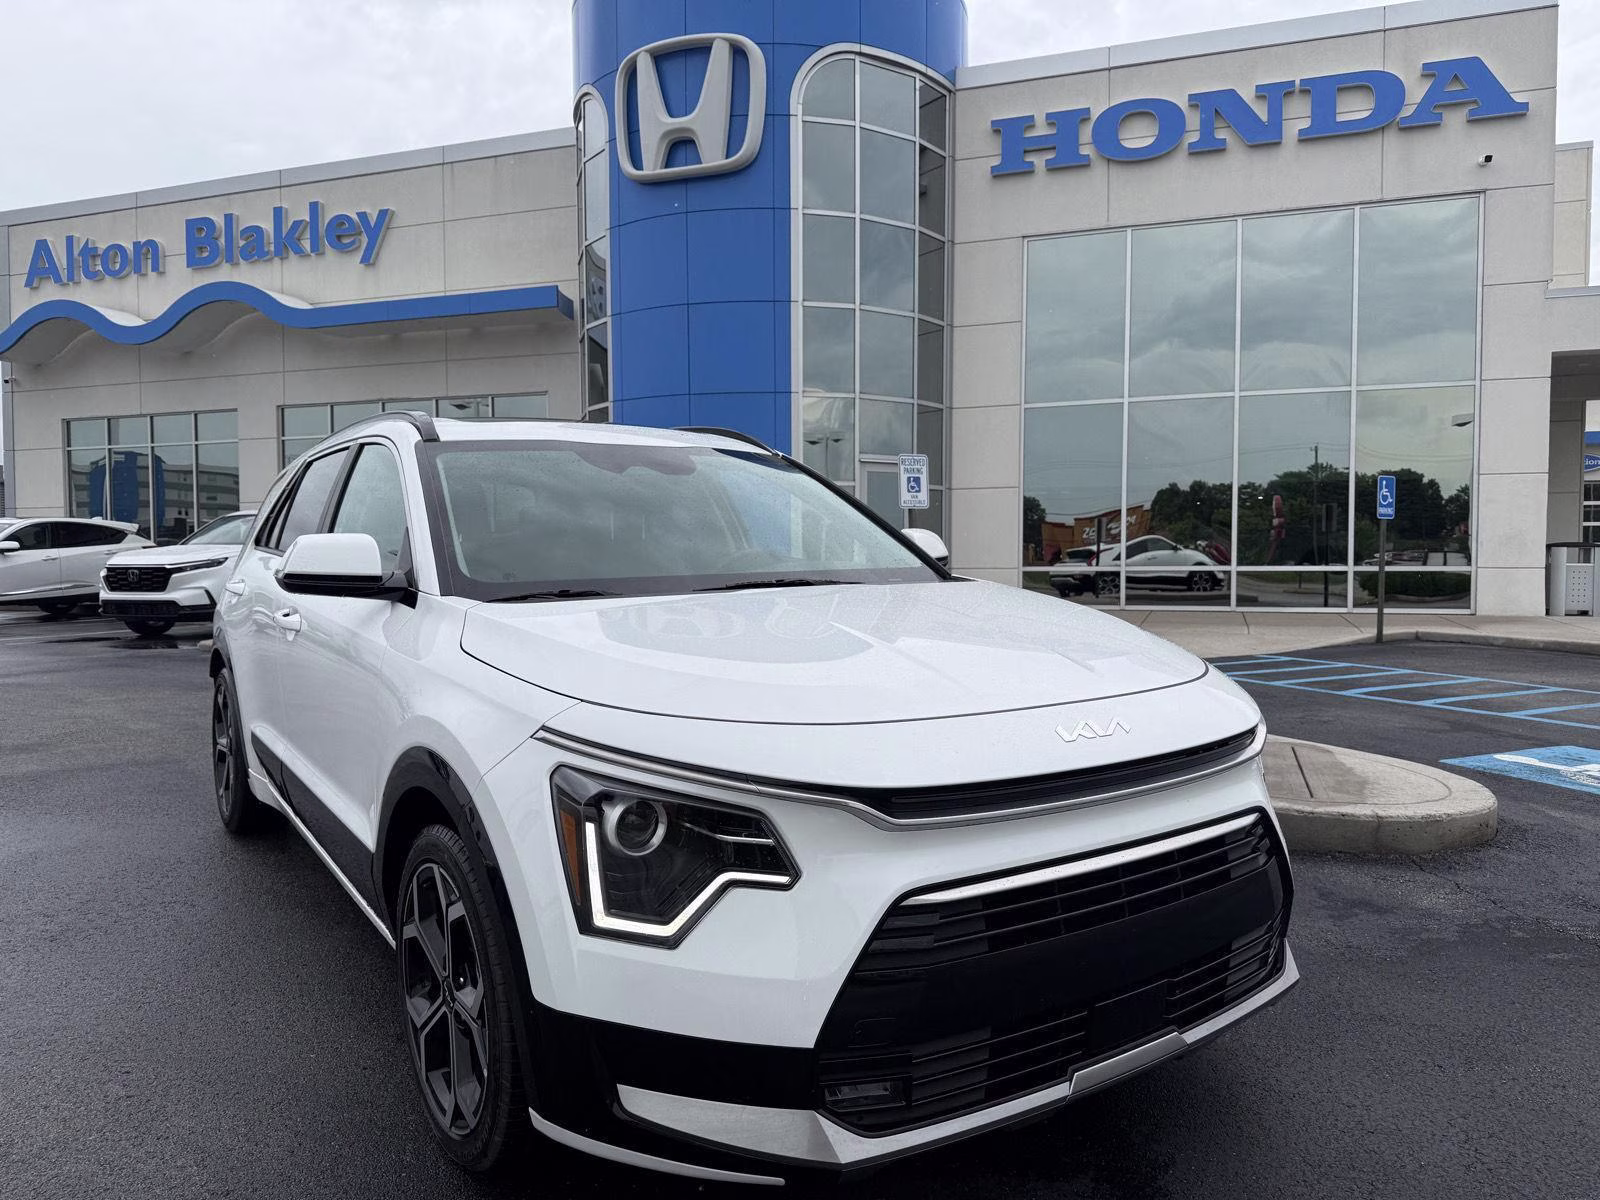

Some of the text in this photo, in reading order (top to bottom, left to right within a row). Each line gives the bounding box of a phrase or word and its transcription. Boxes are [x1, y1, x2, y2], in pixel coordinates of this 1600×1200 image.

[990, 56, 1530, 177] HONDA
[24, 200, 395, 290] Alton Blakley
[901, 458, 925, 466] RESERVED
